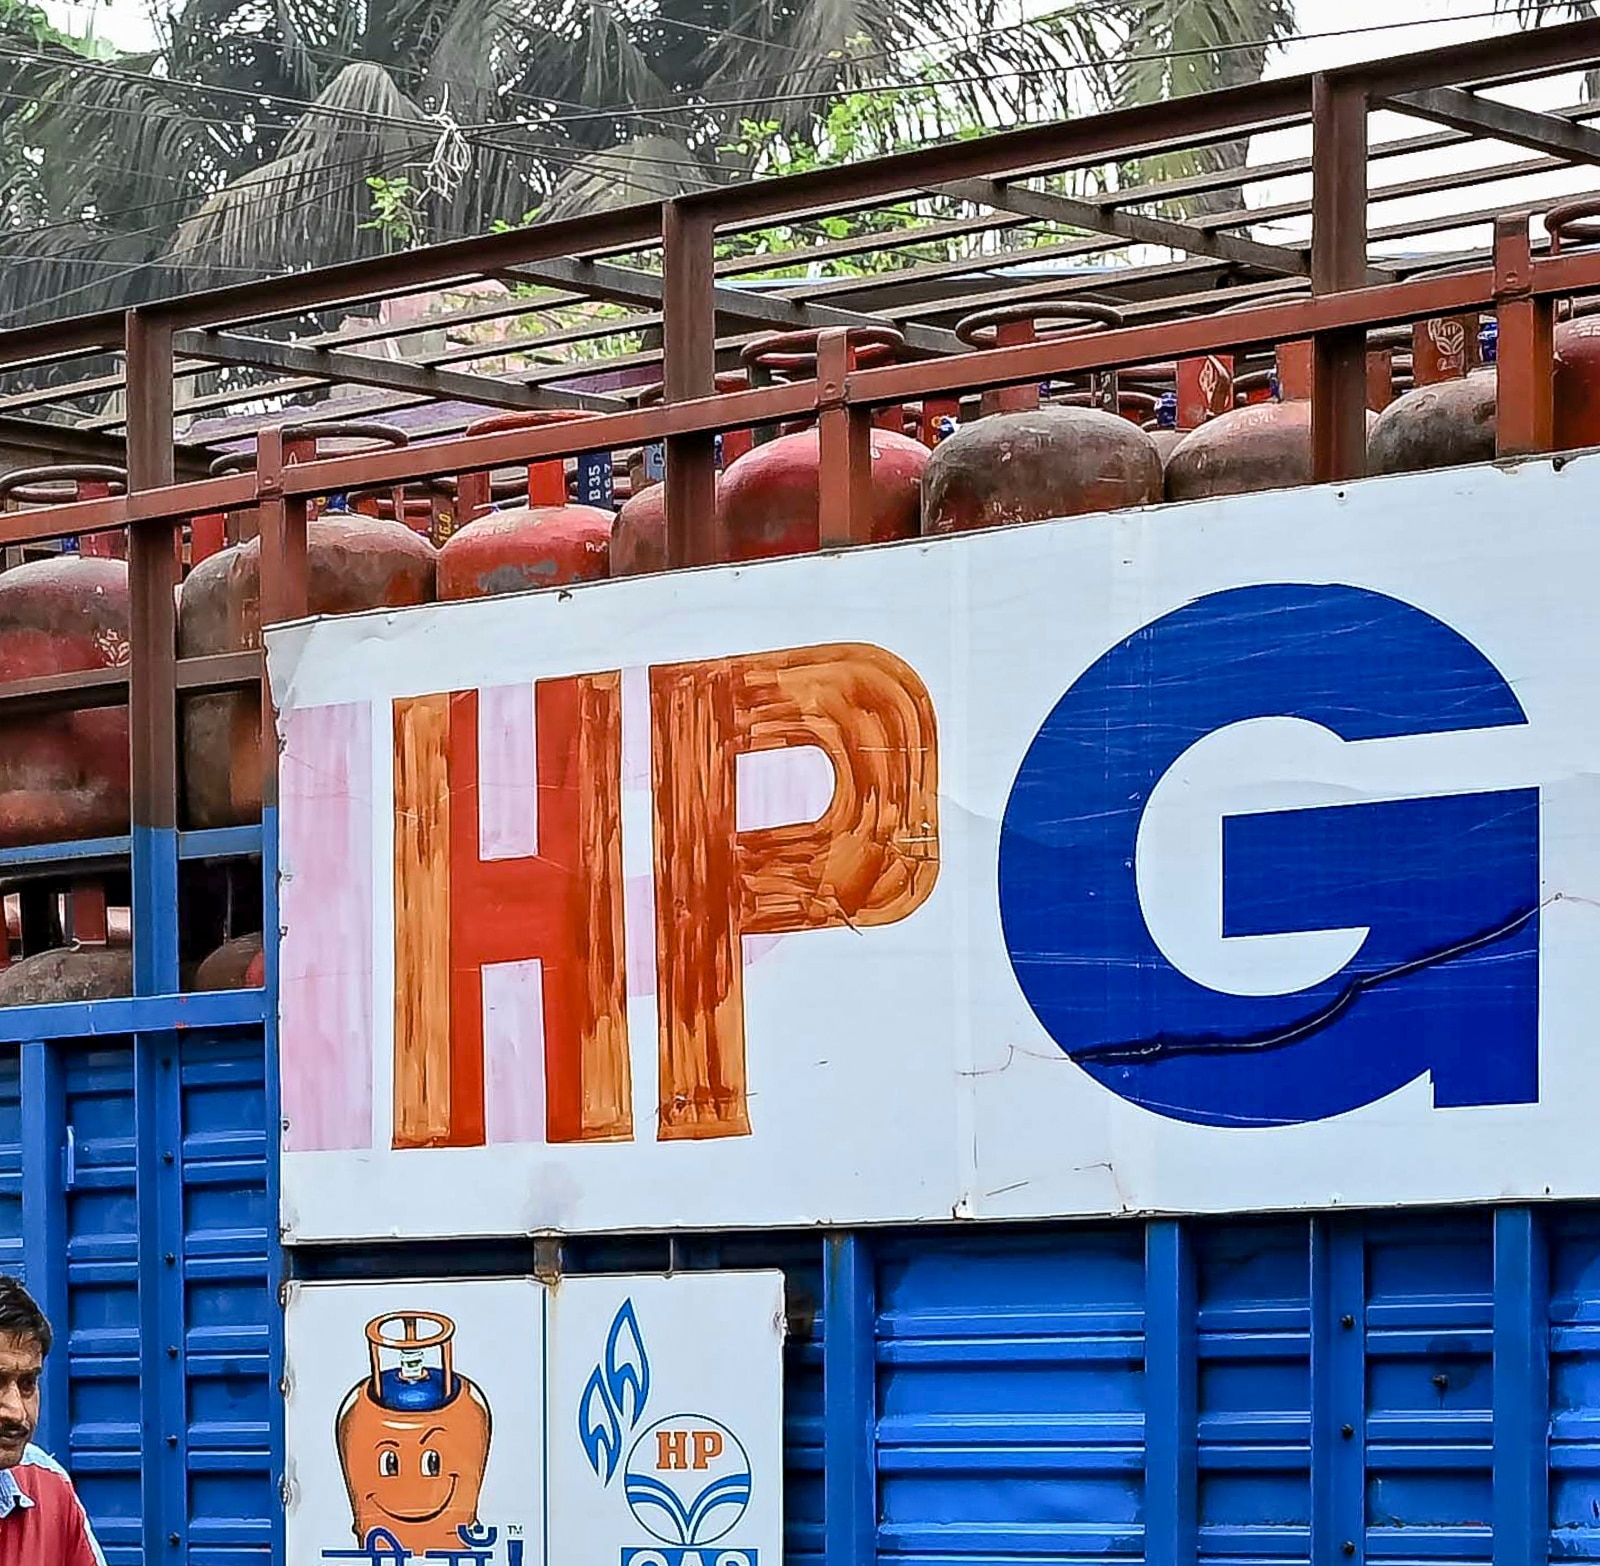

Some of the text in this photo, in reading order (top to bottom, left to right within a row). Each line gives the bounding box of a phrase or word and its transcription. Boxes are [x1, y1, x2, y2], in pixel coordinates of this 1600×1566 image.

[391, 640, 940, 1151] HP
[655, 1430, 724, 1471] HP
[507, 1524, 524, 1535] TM
